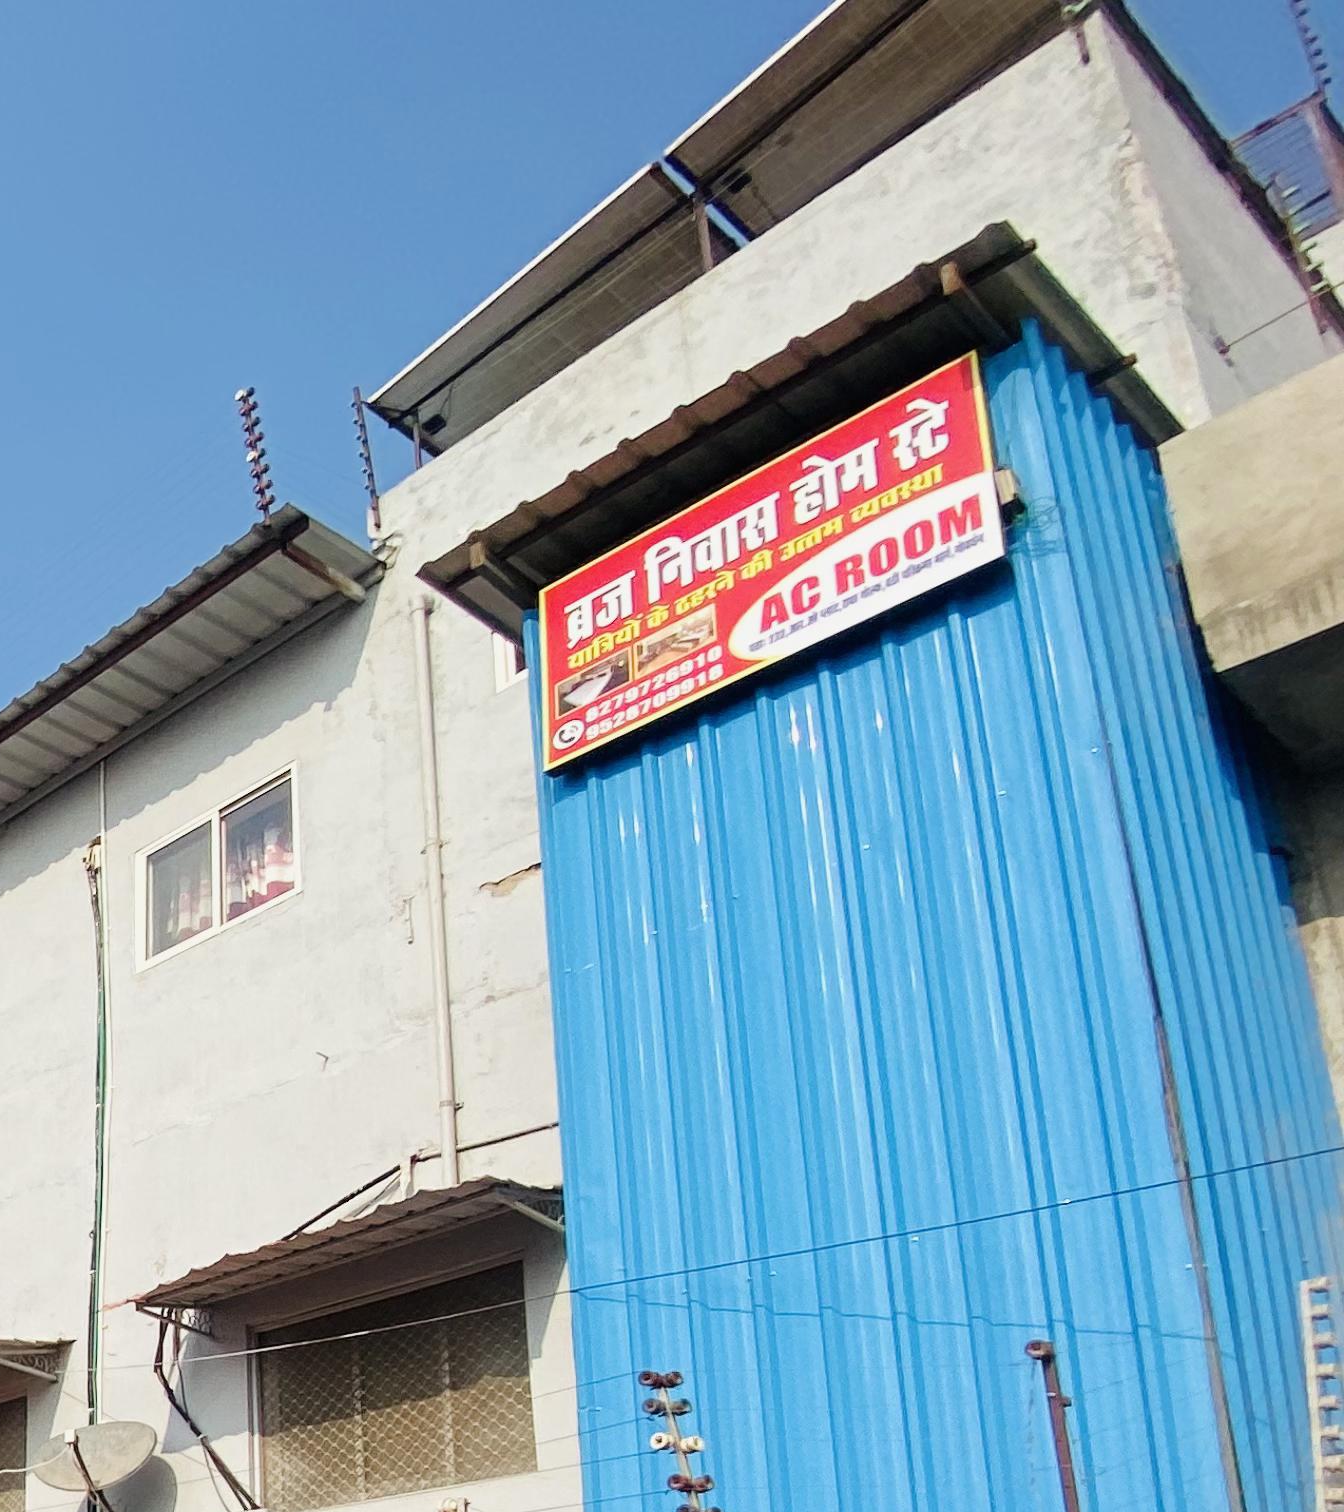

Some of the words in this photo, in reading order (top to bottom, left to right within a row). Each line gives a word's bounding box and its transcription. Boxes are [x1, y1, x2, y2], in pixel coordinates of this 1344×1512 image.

[563, 570, 635, 649] ब्रज
[644, 491, 780, 604] निवास
[789, 454, 879, 524] होम
[889, 398, 949, 471] स्टे
[567, 613, 643, 668] यात्रियों
[646, 604, 669, 628] के
[675, 570, 735, 614] ठहरने
[740, 550, 773, 579] की
[780, 515, 843, 561] उत्तम
[849, 463, 943, 522] व्यवस्था
[760, 576, 820, 633] AC
[834, 495, 983, 595] ROOM
